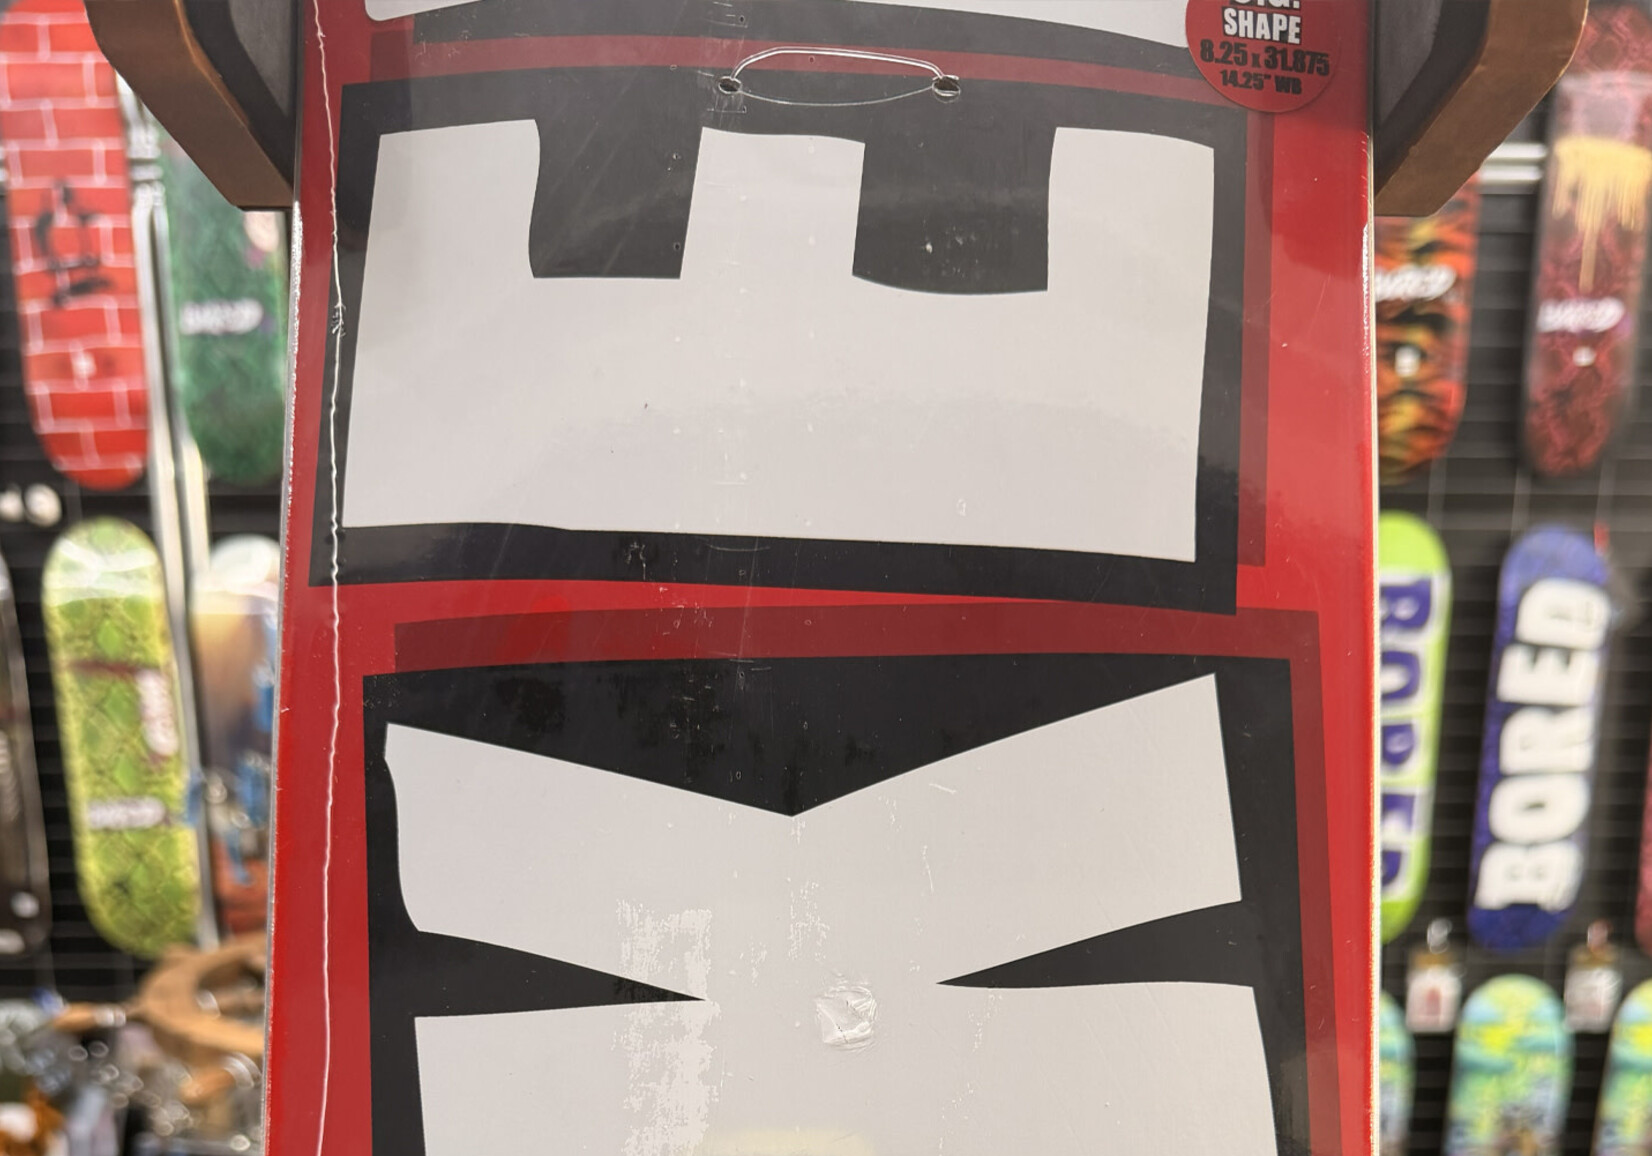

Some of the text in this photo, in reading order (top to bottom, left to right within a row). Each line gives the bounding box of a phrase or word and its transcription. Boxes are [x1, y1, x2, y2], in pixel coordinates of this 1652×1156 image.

[1223, 7, 1301, 44] SHAPE
[1200, 38, 1248, 66] 8.25
[1264, 45, 1330, 76] 31.875
[1274, 75, 1302, 95] WB
[1475, 577, 1611, 912] BORED
